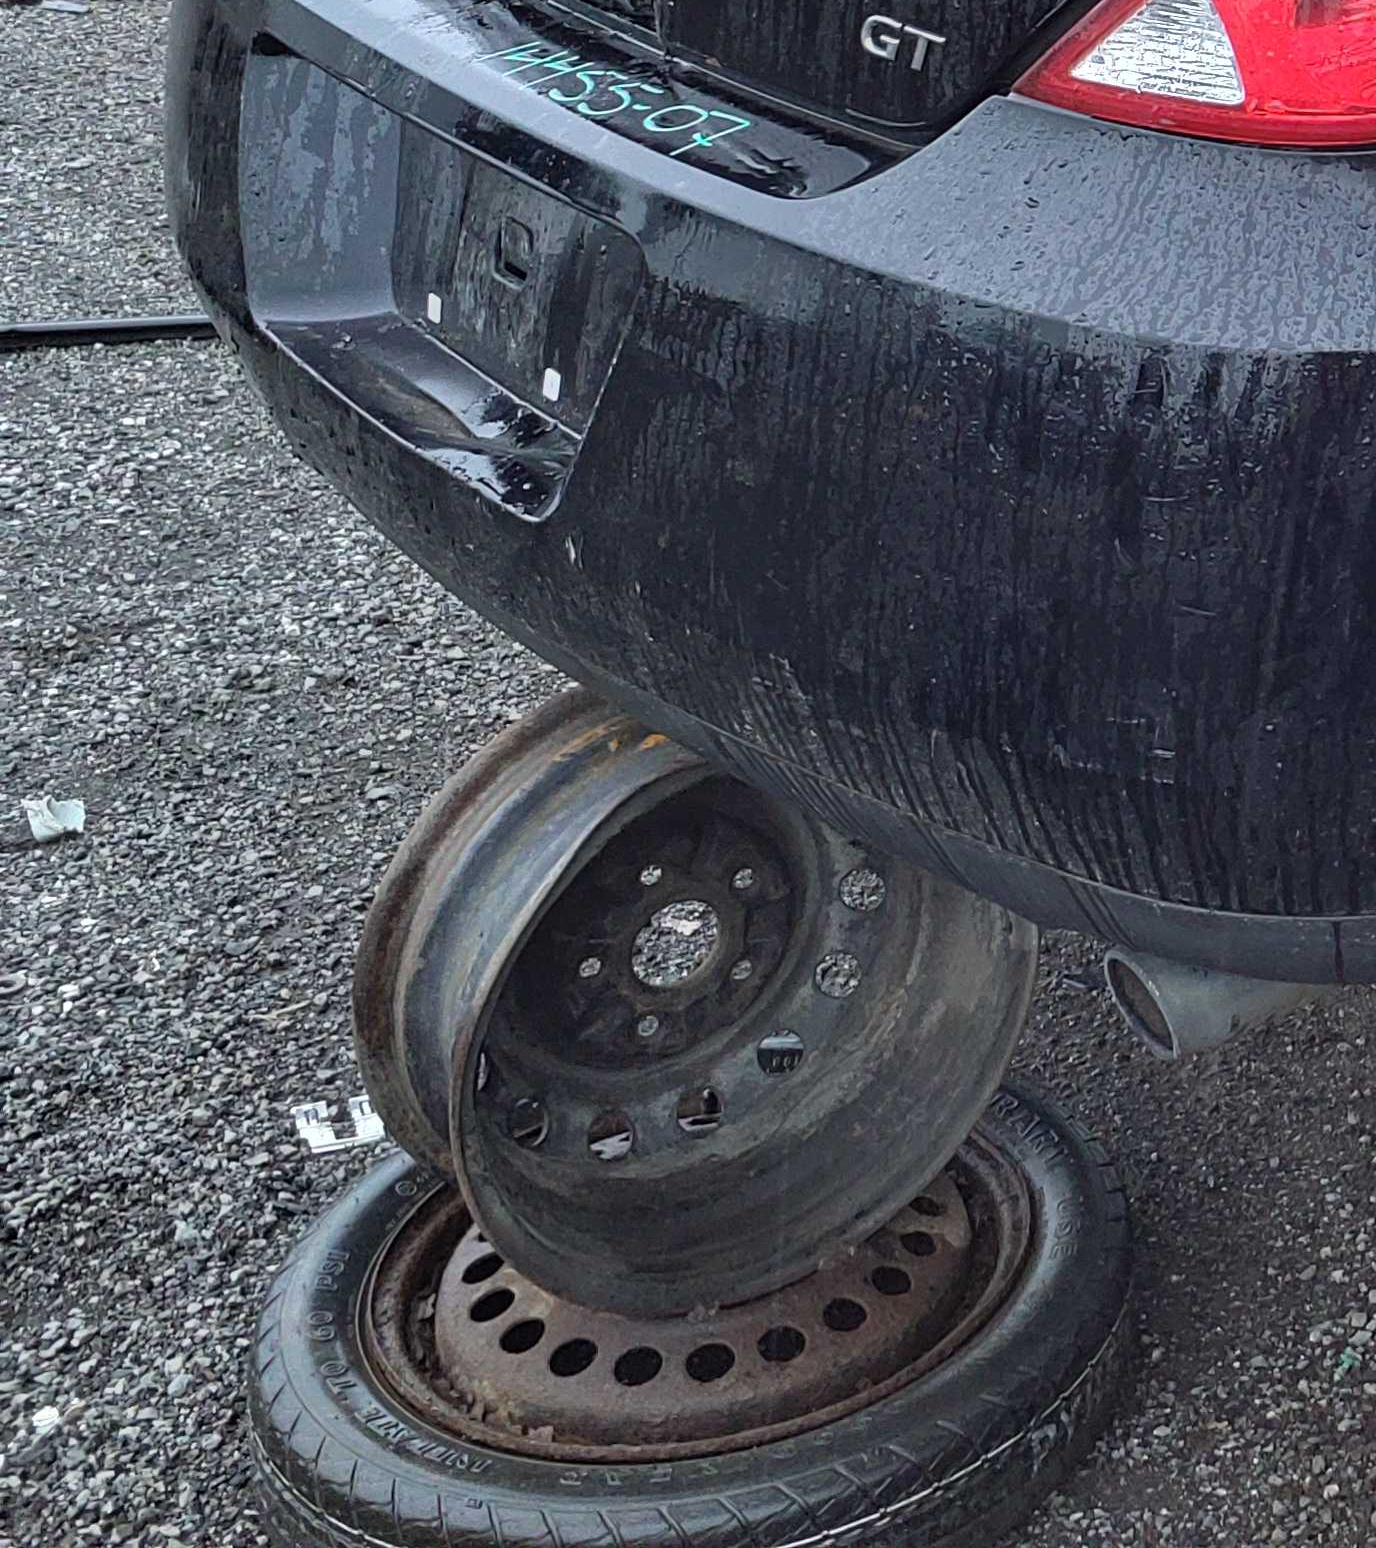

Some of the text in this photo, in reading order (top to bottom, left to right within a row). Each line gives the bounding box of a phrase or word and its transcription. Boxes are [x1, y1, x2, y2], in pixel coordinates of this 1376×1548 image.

[861, 14, 947, 72] GT
[314, 1249, 350, 1294] PSI
[301, 1309, 336, 1342] 60
[319, 1359, 358, 1403] TO
